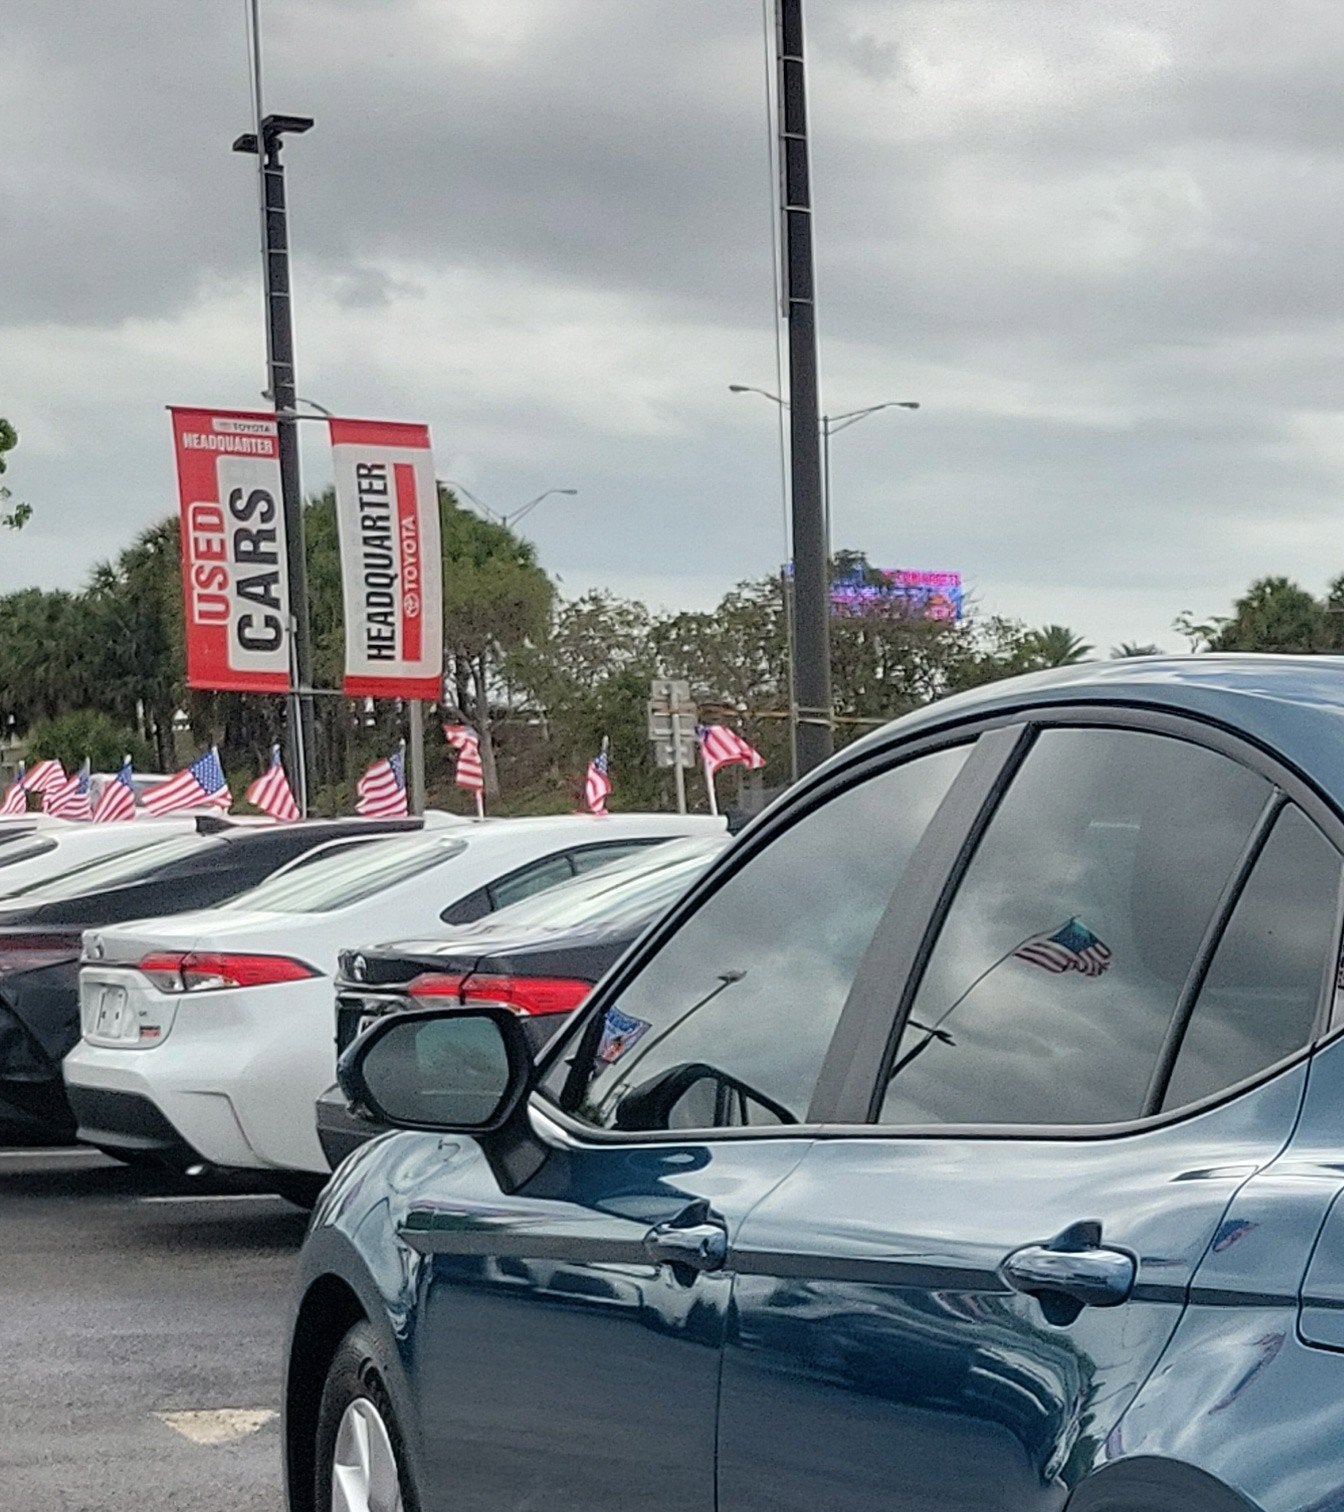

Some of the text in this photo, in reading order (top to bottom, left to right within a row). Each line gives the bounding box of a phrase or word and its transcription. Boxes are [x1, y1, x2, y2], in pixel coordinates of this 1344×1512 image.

[183, 432, 273, 455] HEADQUARTER
[232, 422, 271, 432] TOYOTA
[189, 501, 231, 625] USED
[229, 487, 283, 652] CARS
[356, 462, 399, 661] HEADQUARTER
[402, 515, 419, 598] TOYOTA
